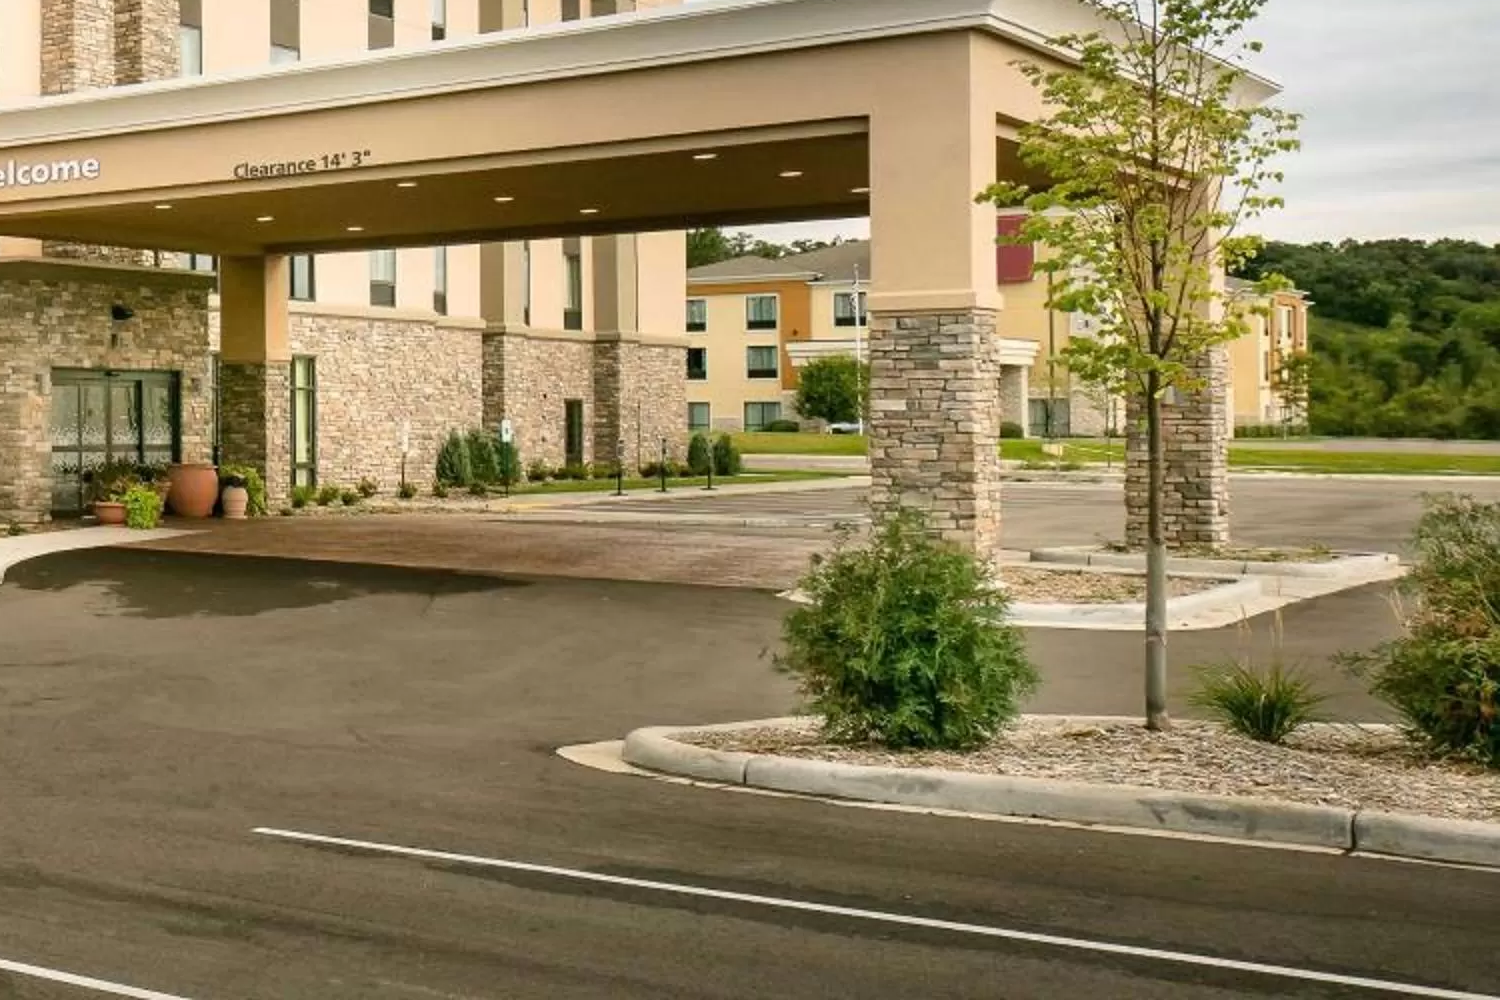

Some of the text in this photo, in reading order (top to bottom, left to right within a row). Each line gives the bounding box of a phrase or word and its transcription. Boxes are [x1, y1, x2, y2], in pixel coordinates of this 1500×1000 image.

[233, 150, 371, 178] Clearance 14' 3"
